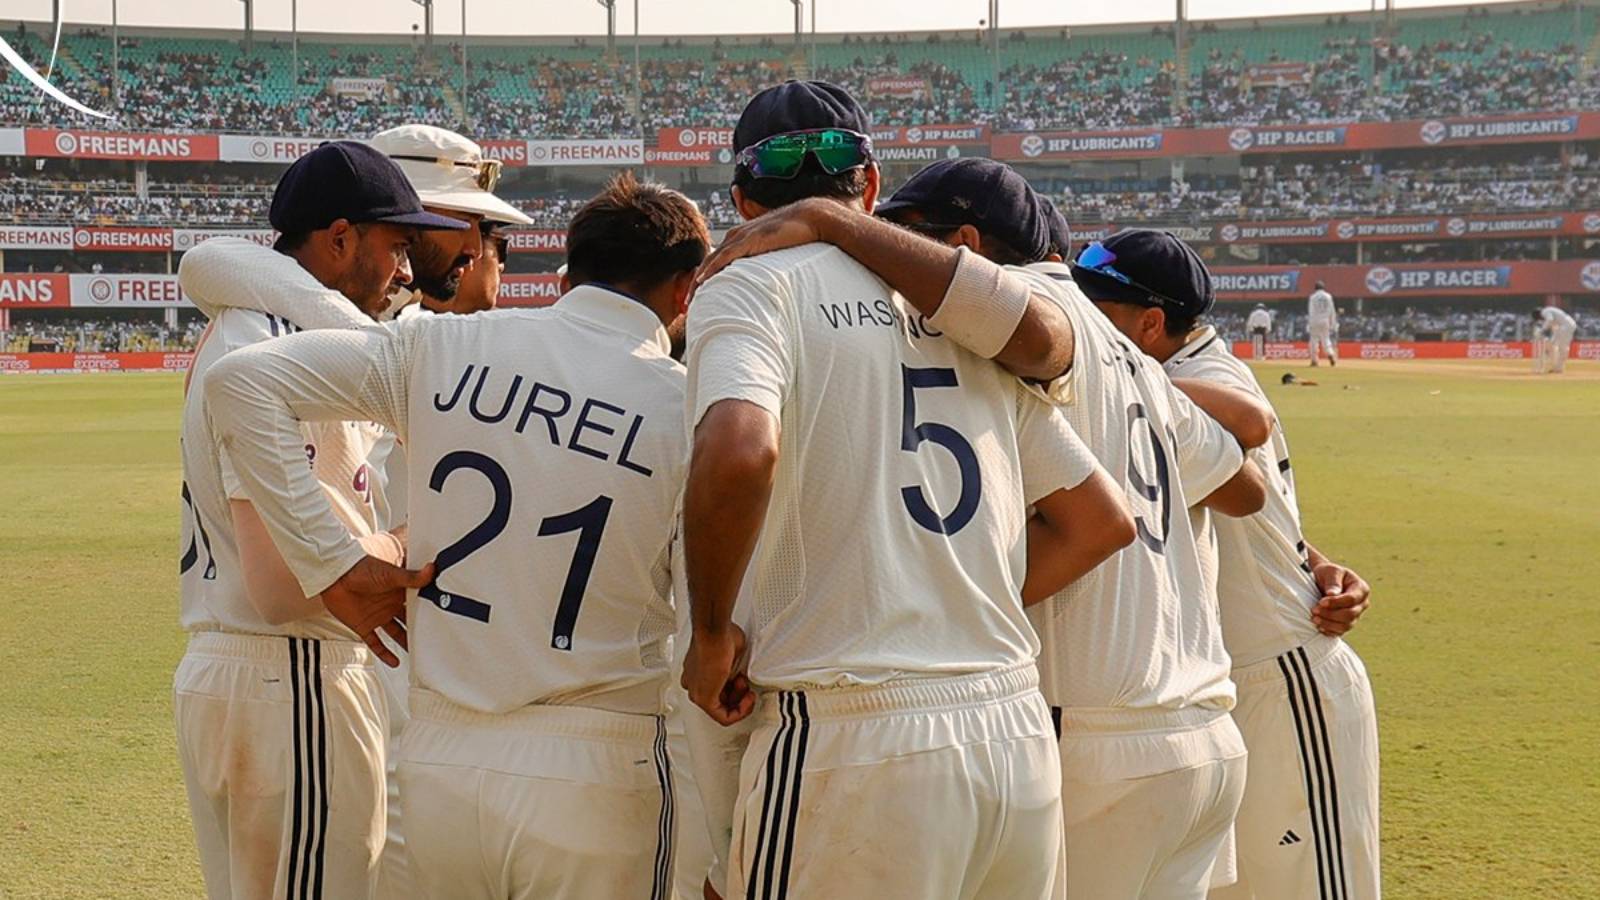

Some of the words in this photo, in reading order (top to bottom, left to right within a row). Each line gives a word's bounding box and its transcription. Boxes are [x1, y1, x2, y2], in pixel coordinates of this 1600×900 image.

[943, 128, 977, 139] RACER
[1451, 124, 1475, 138] HP
[1477, 119, 1571, 136] LUBRICANTS
[79, 135, 190, 156] FREEMANS
[1047, 139, 1070, 151] HP
[1072, 135, 1156, 150] LUBRICANTS
[1257, 131, 1281, 145] HP
[1285, 130, 1336, 144] RACER
[551, 144, 641, 159] FREEMANS
[656, 151, 711, 161] FREEMANS
[1260, 226, 1324, 237] LUBRICANTS
[1489, 218, 1557, 231] LUBRICANTS
[92, 231, 172, 247] FREEMANS
[1401, 271, 1430, 288] HP
[1434, 270, 1498, 286] RACER
[118, 280, 182, 301] FREE
[74, 359, 120, 370] express
[433, 363, 653, 478] JUREL
[900, 362, 982, 537] 5
[1126, 402, 1179, 556] 9
[417, 449, 614, 651] 21
